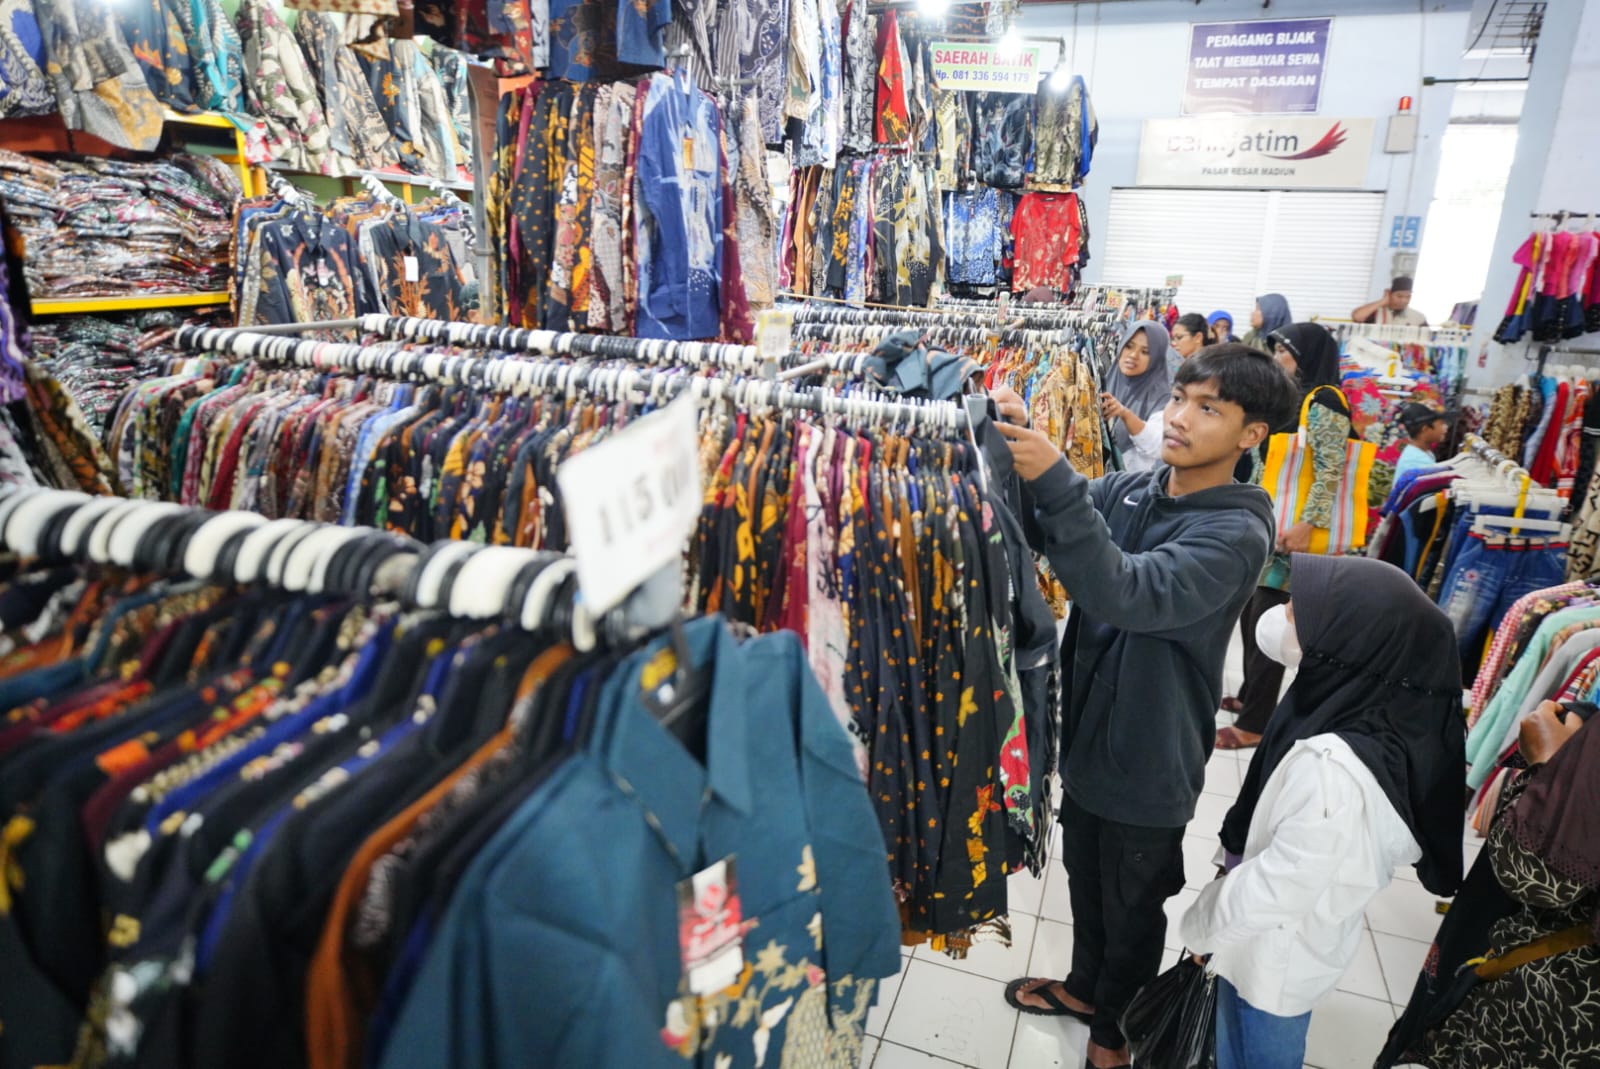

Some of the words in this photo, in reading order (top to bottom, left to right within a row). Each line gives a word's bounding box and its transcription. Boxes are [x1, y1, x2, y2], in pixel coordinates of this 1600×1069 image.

[1206, 33, 1274, 48] PEDAGANG
[1276, 31, 1316, 45] BIJAK
[935, 49, 988, 65] SAERAH
[1194, 55, 1222, 69] TAAT
[1223, 54, 1285, 67] MEMBAYAR
[1287, 52, 1320, 65] SEWA
[935, 69, 949, 83] Hp.
[952, 69, 969, 80] 081
[972, 70, 989, 81] 336
[992, 71, 1009, 82] 594
[1195, 76, 1247, 89] TEMPAT
[1249, 75, 1316, 88] DASARAN
